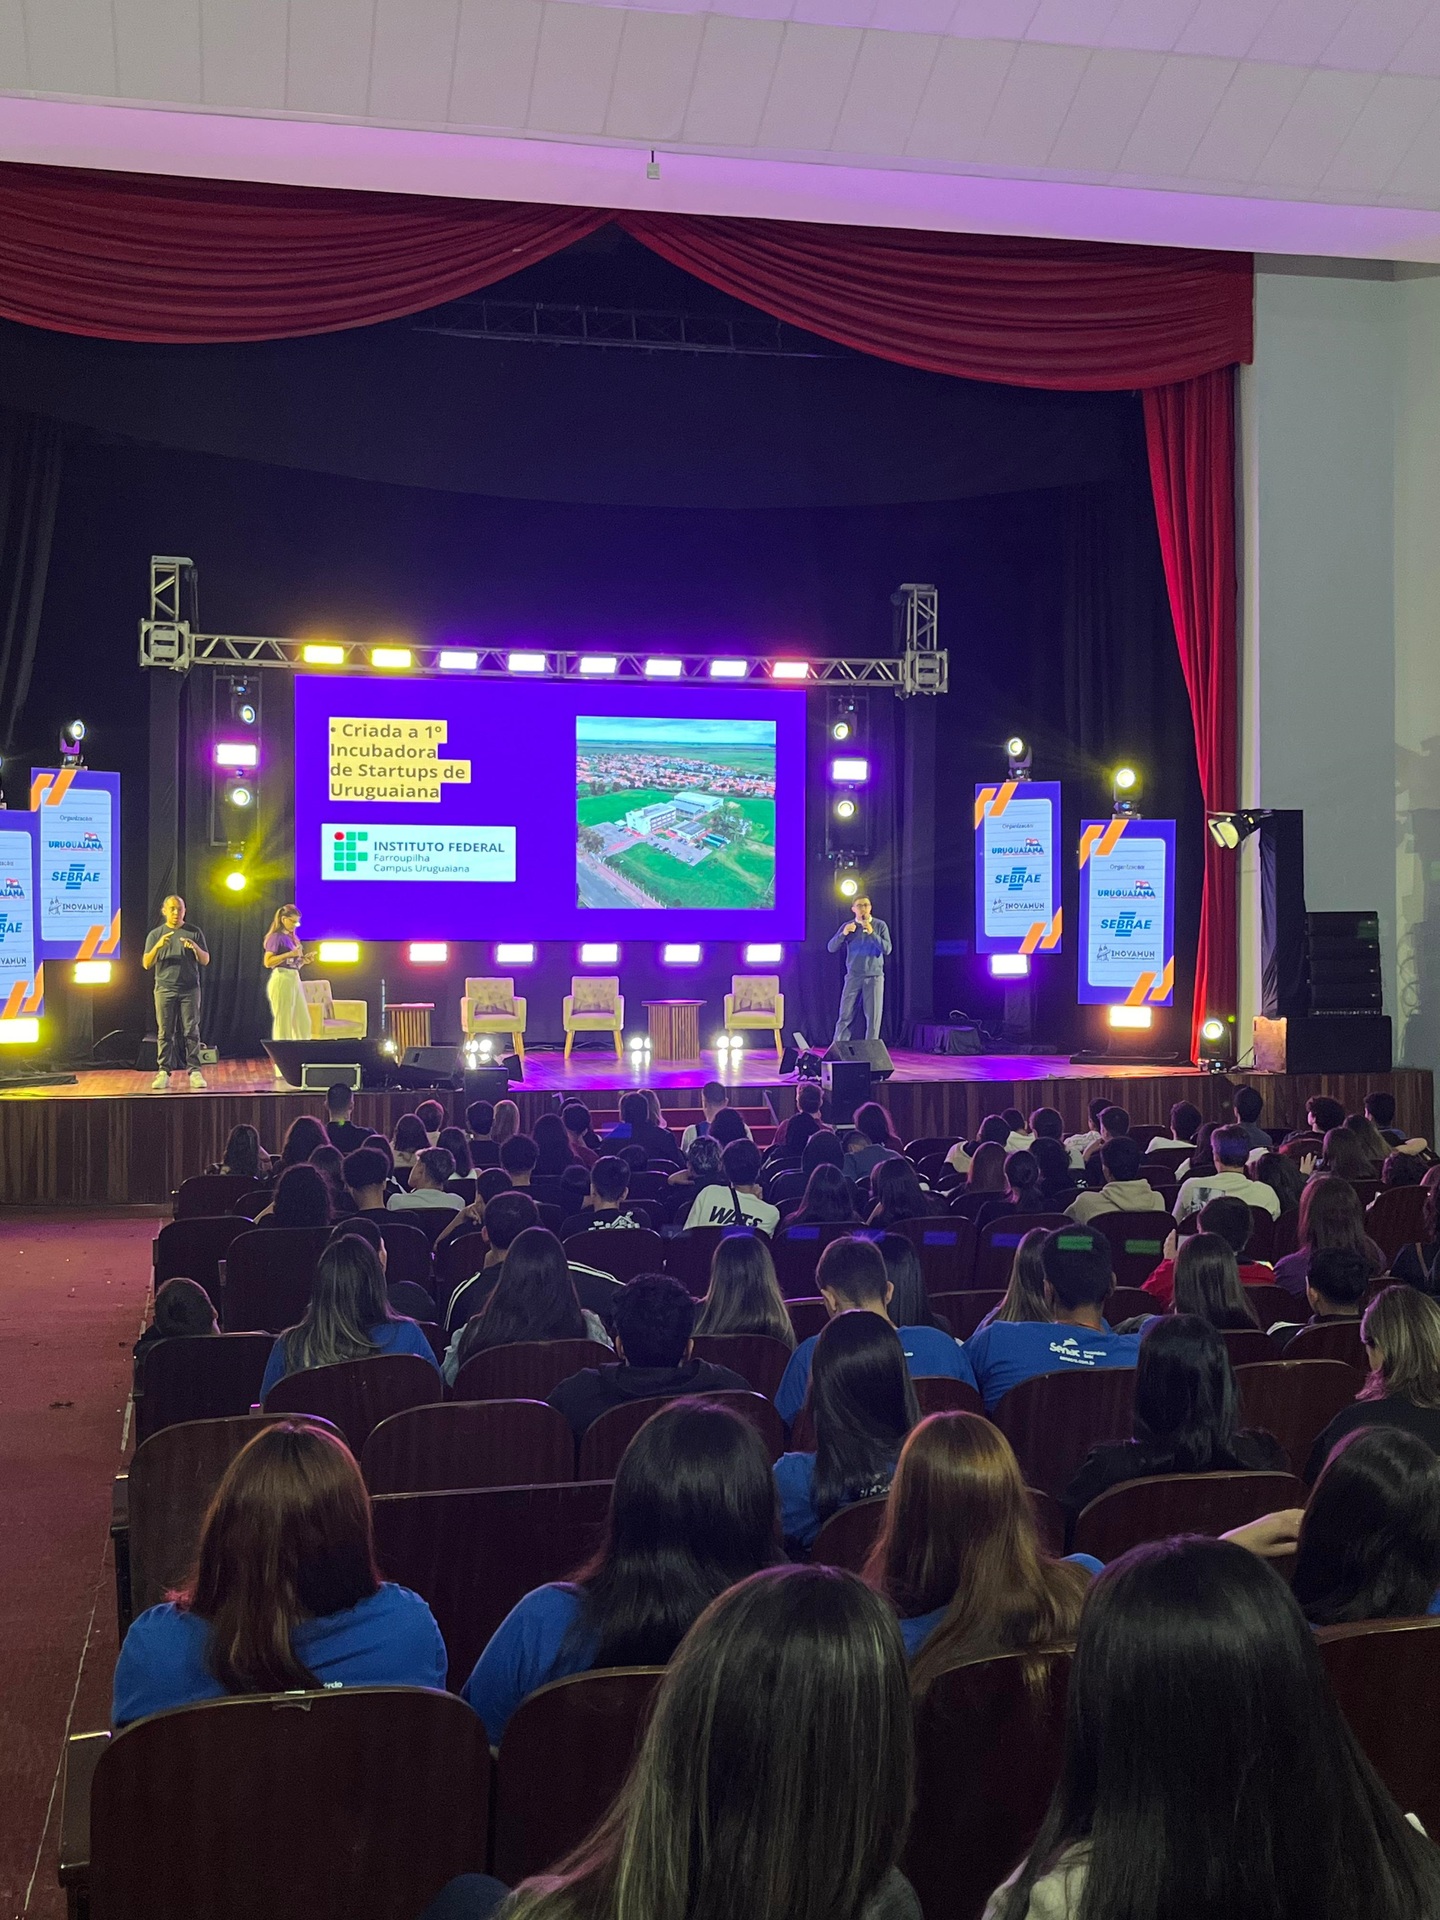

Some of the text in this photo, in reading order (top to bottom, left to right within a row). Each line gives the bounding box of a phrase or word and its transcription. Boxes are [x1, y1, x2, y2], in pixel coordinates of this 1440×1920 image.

[342, 723, 402, 738] Criada
[408, 728, 418, 738] a
[330, 743, 437, 759] Incubadora
[330, 762, 466, 782] de Startups de
[330, 783, 440, 800] Uruguaiana
[48, 840, 104, 850] URUGUAIANA
[373, 841, 505, 853] INSTITUTO FEDERAL
[991, 846, 1045, 855] URUGUAIANA
[373, 853, 430, 863] Farroupilha
[373, 863, 470, 875] Campus Uruguaiana
[51, 871, 101, 882] SEBRAE
[994, 874, 1042, 884] SEBRAE
[1097, 889, 1156, 898] URUGUAIANA
[62, 903, 104, 911] INOVAMUN
[1005, 902, 1045, 910] INOVAMUN
[1100, 919, 1153, 930] SEBRAE
[1111, 949, 1155, 958] INOVAMUN
